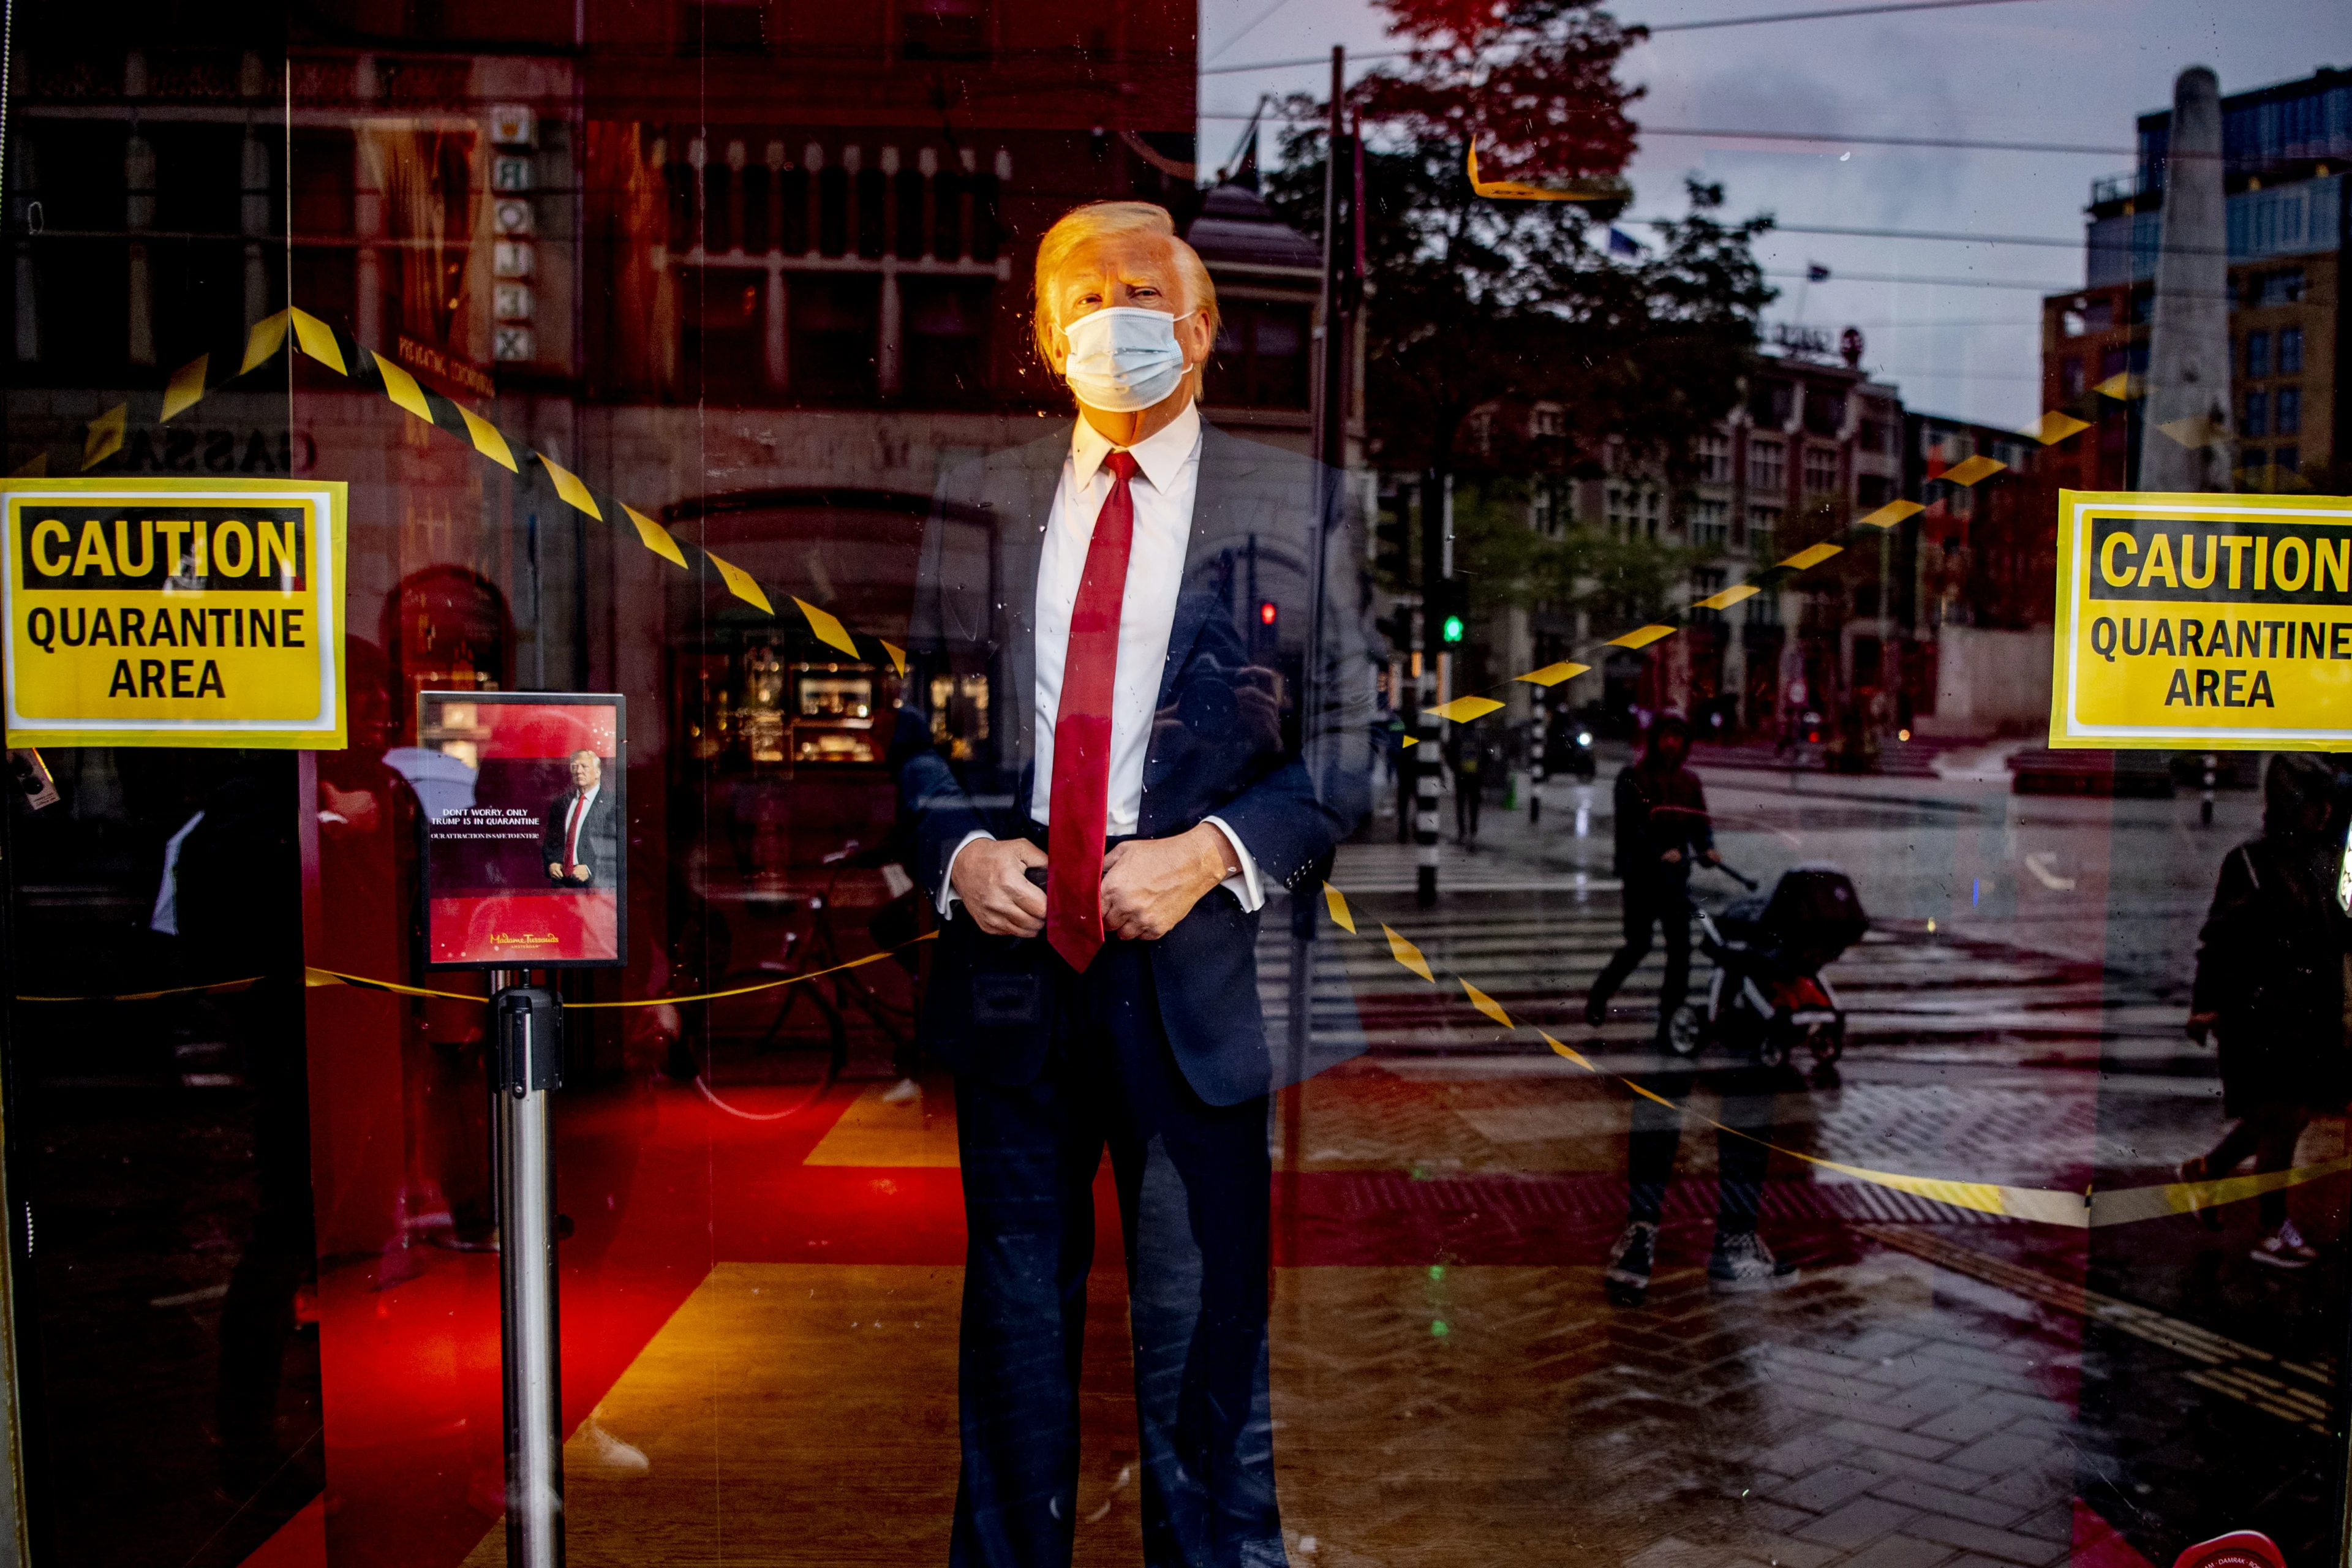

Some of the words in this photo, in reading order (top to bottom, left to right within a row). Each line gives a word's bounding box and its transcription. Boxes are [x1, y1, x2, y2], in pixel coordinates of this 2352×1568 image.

[31, 520, 297, 578] CAUTION
[2100, 531, 2351, 592] CAUTION
[28, 608, 305, 653] QUARANTINE
[2090, 616, 2352, 662] QUARANTINE
[109, 659, 225, 698] AREA
[2164, 668, 2275, 708] AREA
[490, 933, 526, 944] Madame
[523, 933, 559, 943] Tussauds
